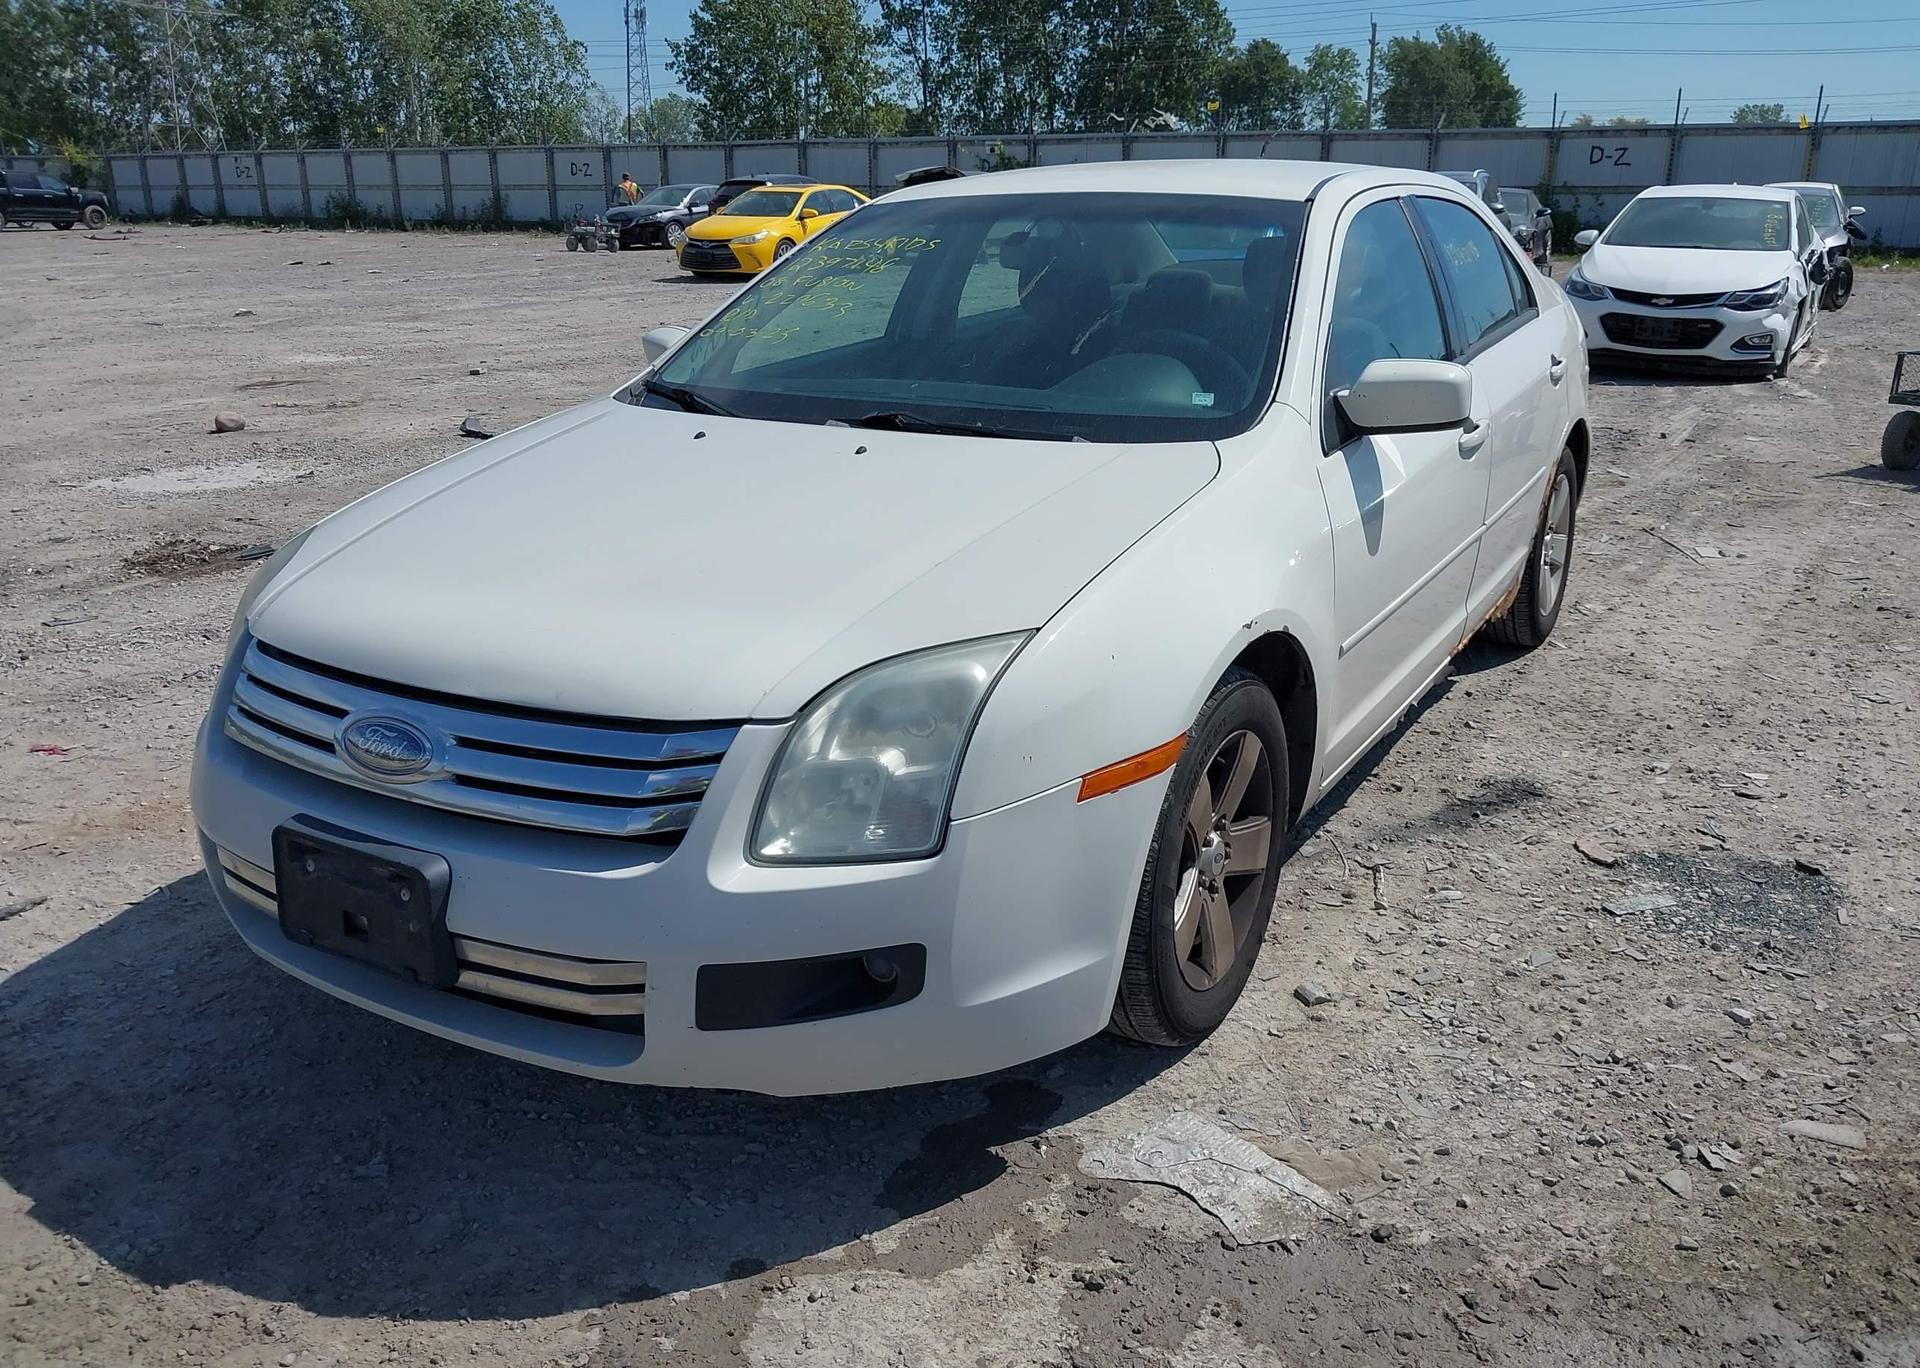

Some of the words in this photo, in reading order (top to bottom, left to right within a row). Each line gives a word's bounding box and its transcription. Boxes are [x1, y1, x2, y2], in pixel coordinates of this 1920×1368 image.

[1590, 145, 1632, 166] D-Z
[570, 162, 593, 177] D-Z
[359, 726, 405, 759] Ford
